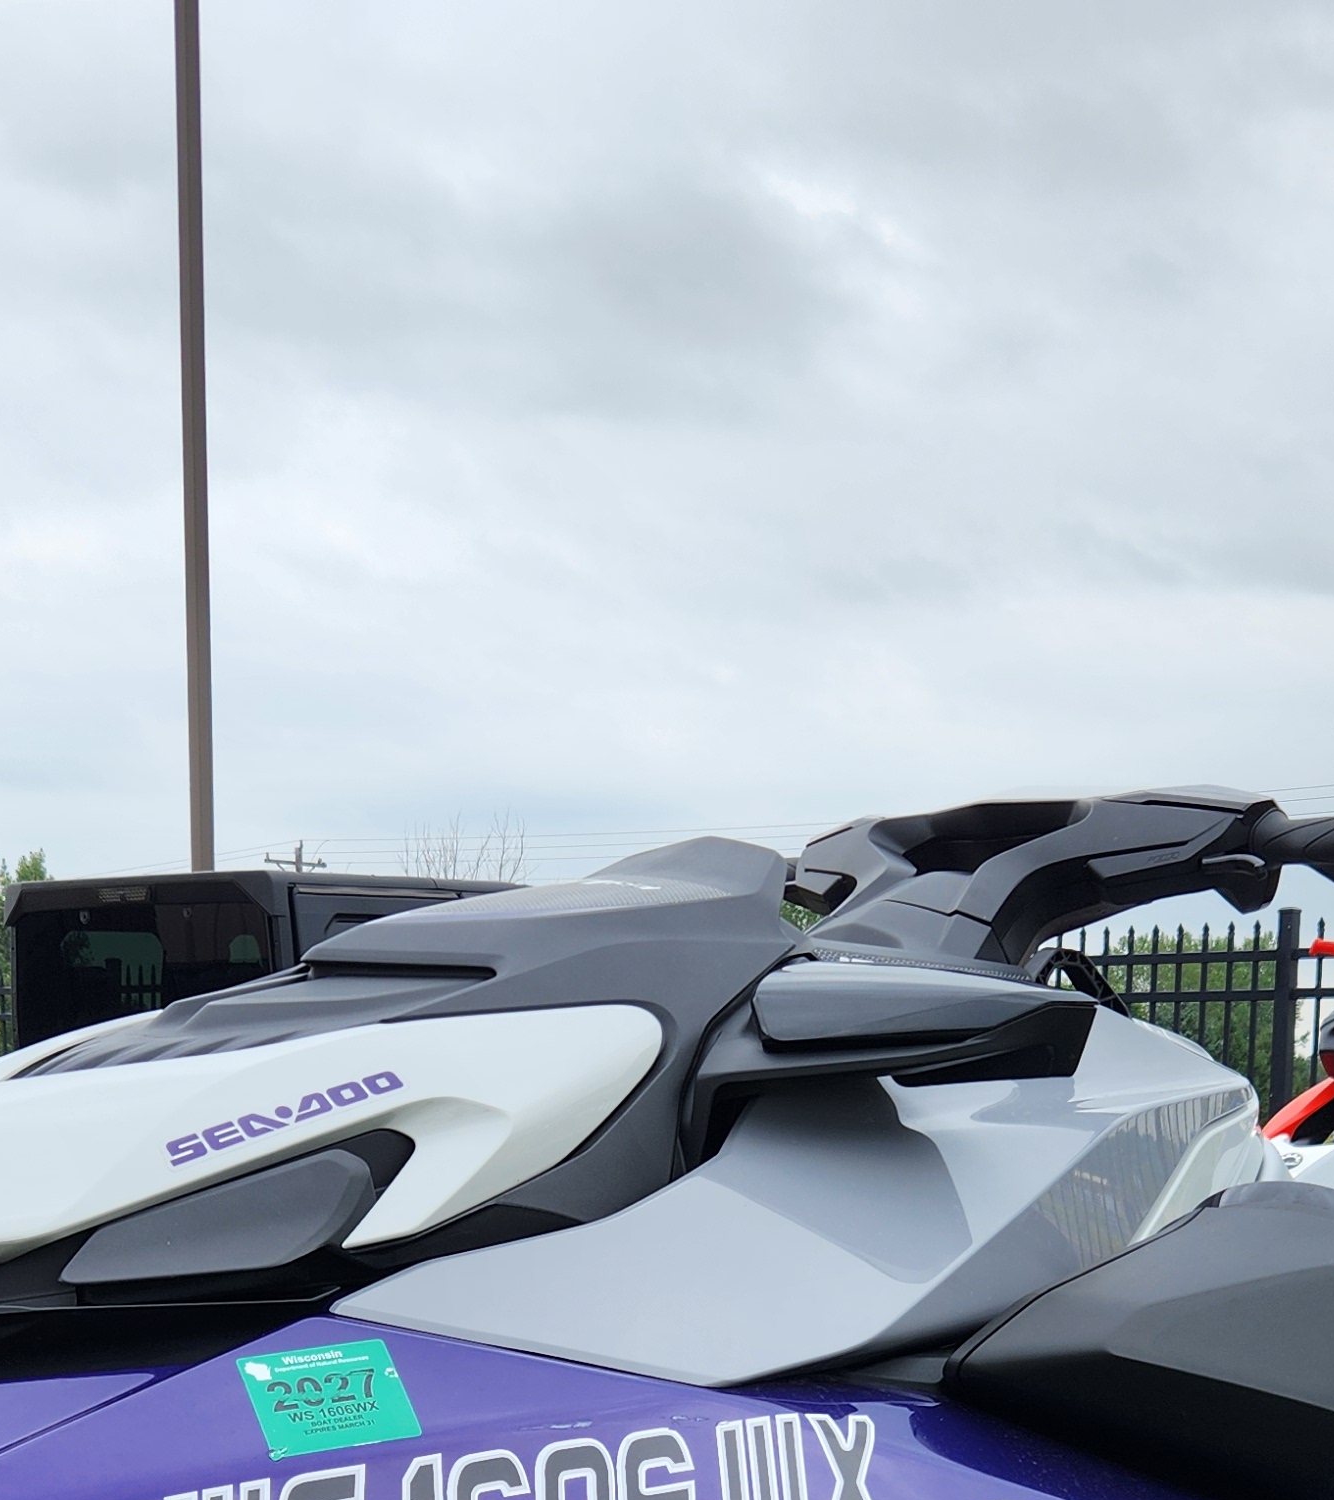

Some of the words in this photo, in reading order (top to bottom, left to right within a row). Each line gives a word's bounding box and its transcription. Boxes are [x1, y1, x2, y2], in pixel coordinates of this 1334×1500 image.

[274, 1363, 309, 1373] Department
[309, 1361, 316, 1369] of
[316, 1358, 338, 1367] Natural
[338, 1355, 370, 1365] Resources
[281, 1350, 343, 1366] Wisconsin
[266, 1368, 374, 1412] 2027
[288, 1410, 314, 1423] WS
[319, 1400, 379, 1419] 1606WX
[304, 1425, 337, 1435] EXPIRES
[337, 1420, 366, 1431] MARCH
[311, 1419, 332, 1427] BOAT
[334, 1414, 364, 1424] DEALER
